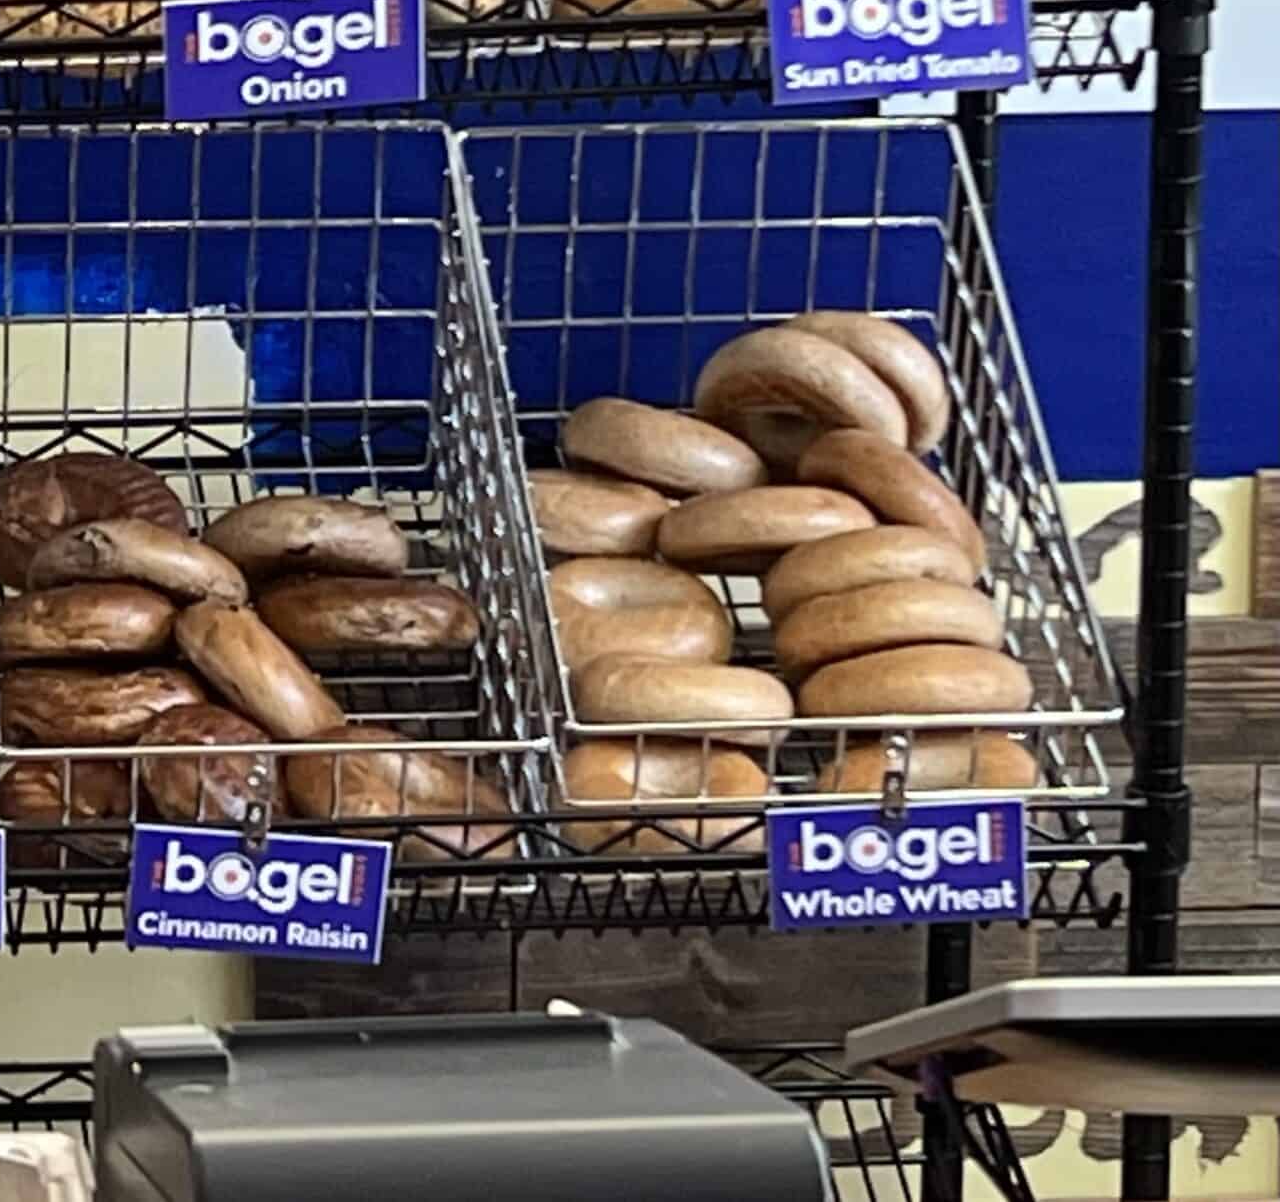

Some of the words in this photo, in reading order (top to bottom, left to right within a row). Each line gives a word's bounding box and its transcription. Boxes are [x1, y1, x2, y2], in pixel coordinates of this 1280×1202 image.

[240, 71, 347, 105] Onion
[784, 62, 839, 90] Sun
[843, 55, 919, 85] Dried
[921, 48, 1021, 80] Tomato
[782, 886, 897, 918] Whole
[899, 880, 1018, 912] Wheat
[137, 910, 278, 944] Cinnamon
[286, 921, 369, 951] Raisin
